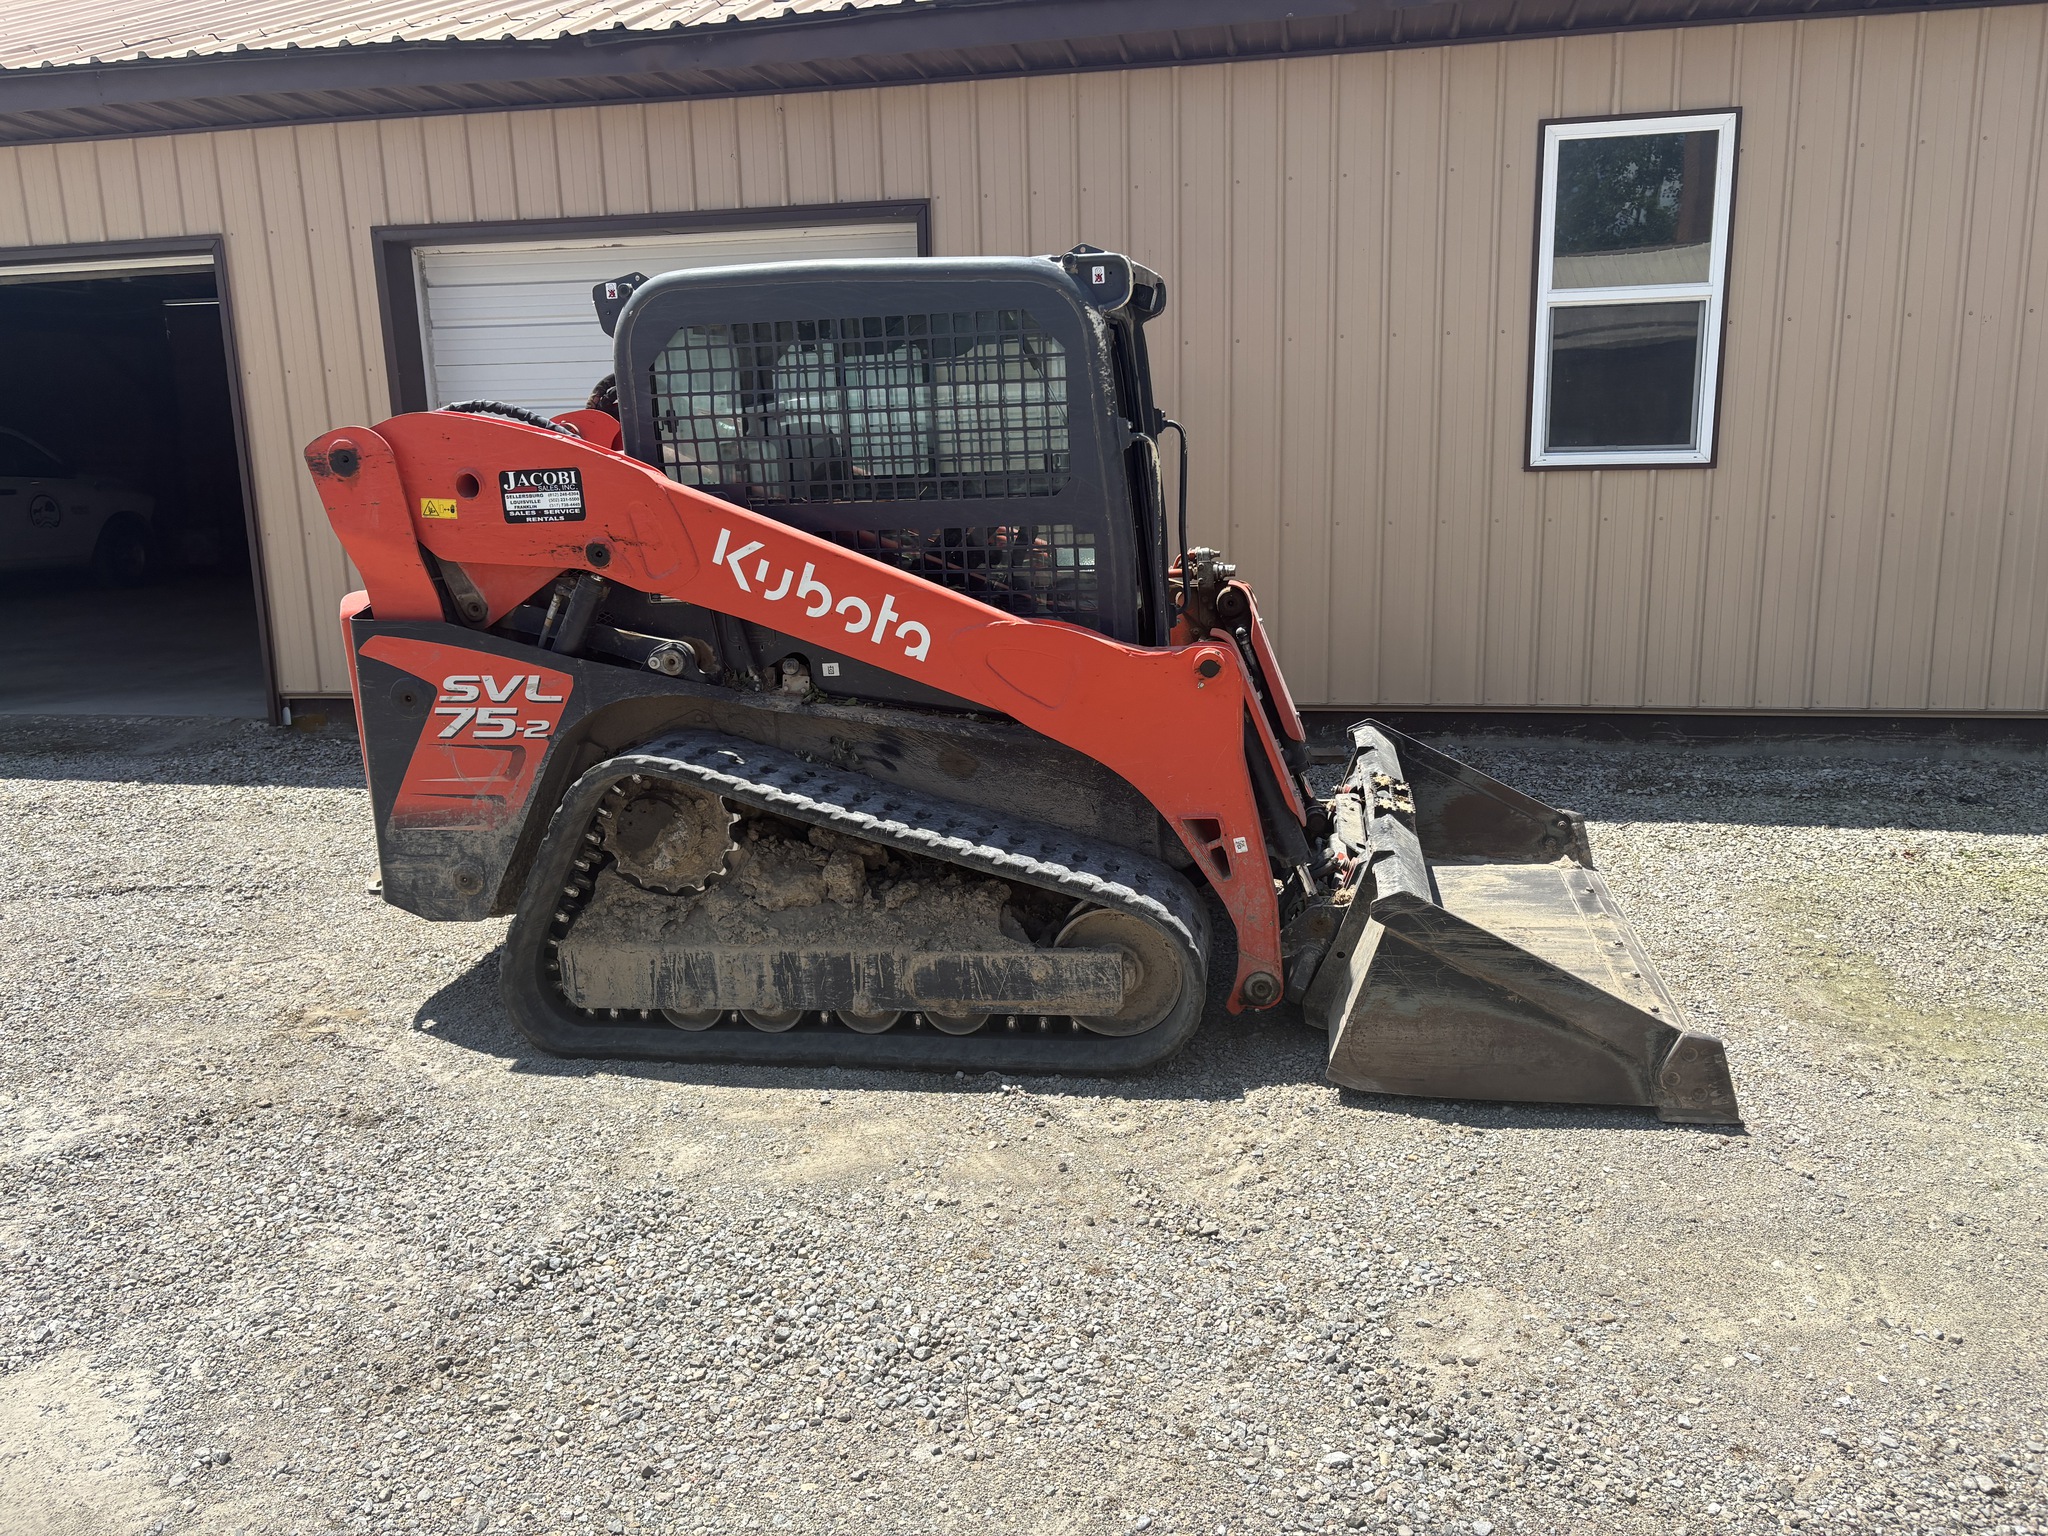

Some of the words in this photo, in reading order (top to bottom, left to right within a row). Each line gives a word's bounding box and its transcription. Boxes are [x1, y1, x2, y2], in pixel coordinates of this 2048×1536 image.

[503, 470, 578, 490] JACOBI
[712, 528, 931, 662] Kubota
[438, 675, 564, 702] SVL
[434, 707, 550, 738] 75-2
